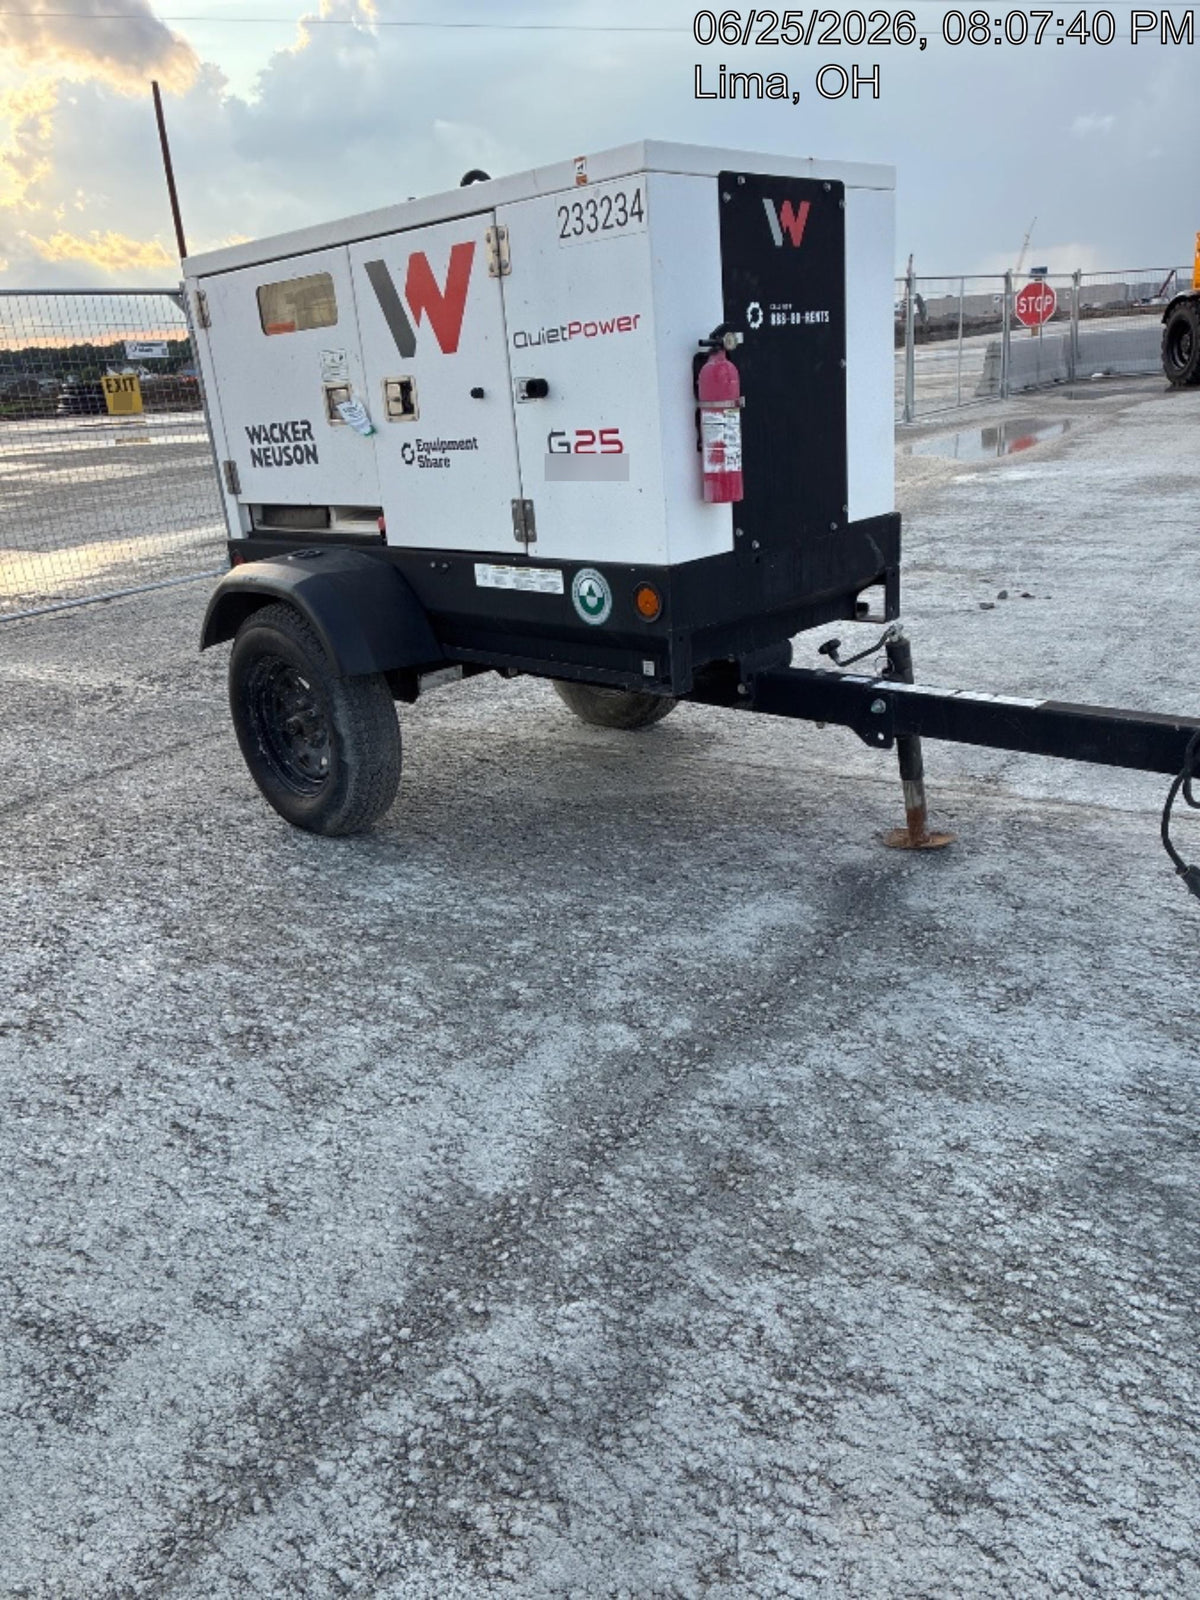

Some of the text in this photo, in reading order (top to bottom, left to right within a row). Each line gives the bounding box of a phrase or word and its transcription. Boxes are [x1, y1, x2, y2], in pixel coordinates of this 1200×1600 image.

[557, 187, 645, 239] 233234
[1018, 294, 1054, 314] STOP
[513, 313, 641, 349] QuietPower
[105, 376, 135, 393] EXIT
[245, 419, 315, 446] WACKER
[416, 436, 479, 455] Equipment
[547, 427, 624, 454] G25
[250, 442, 320, 468] NEUSON
[417, 455, 451, 469] Share
